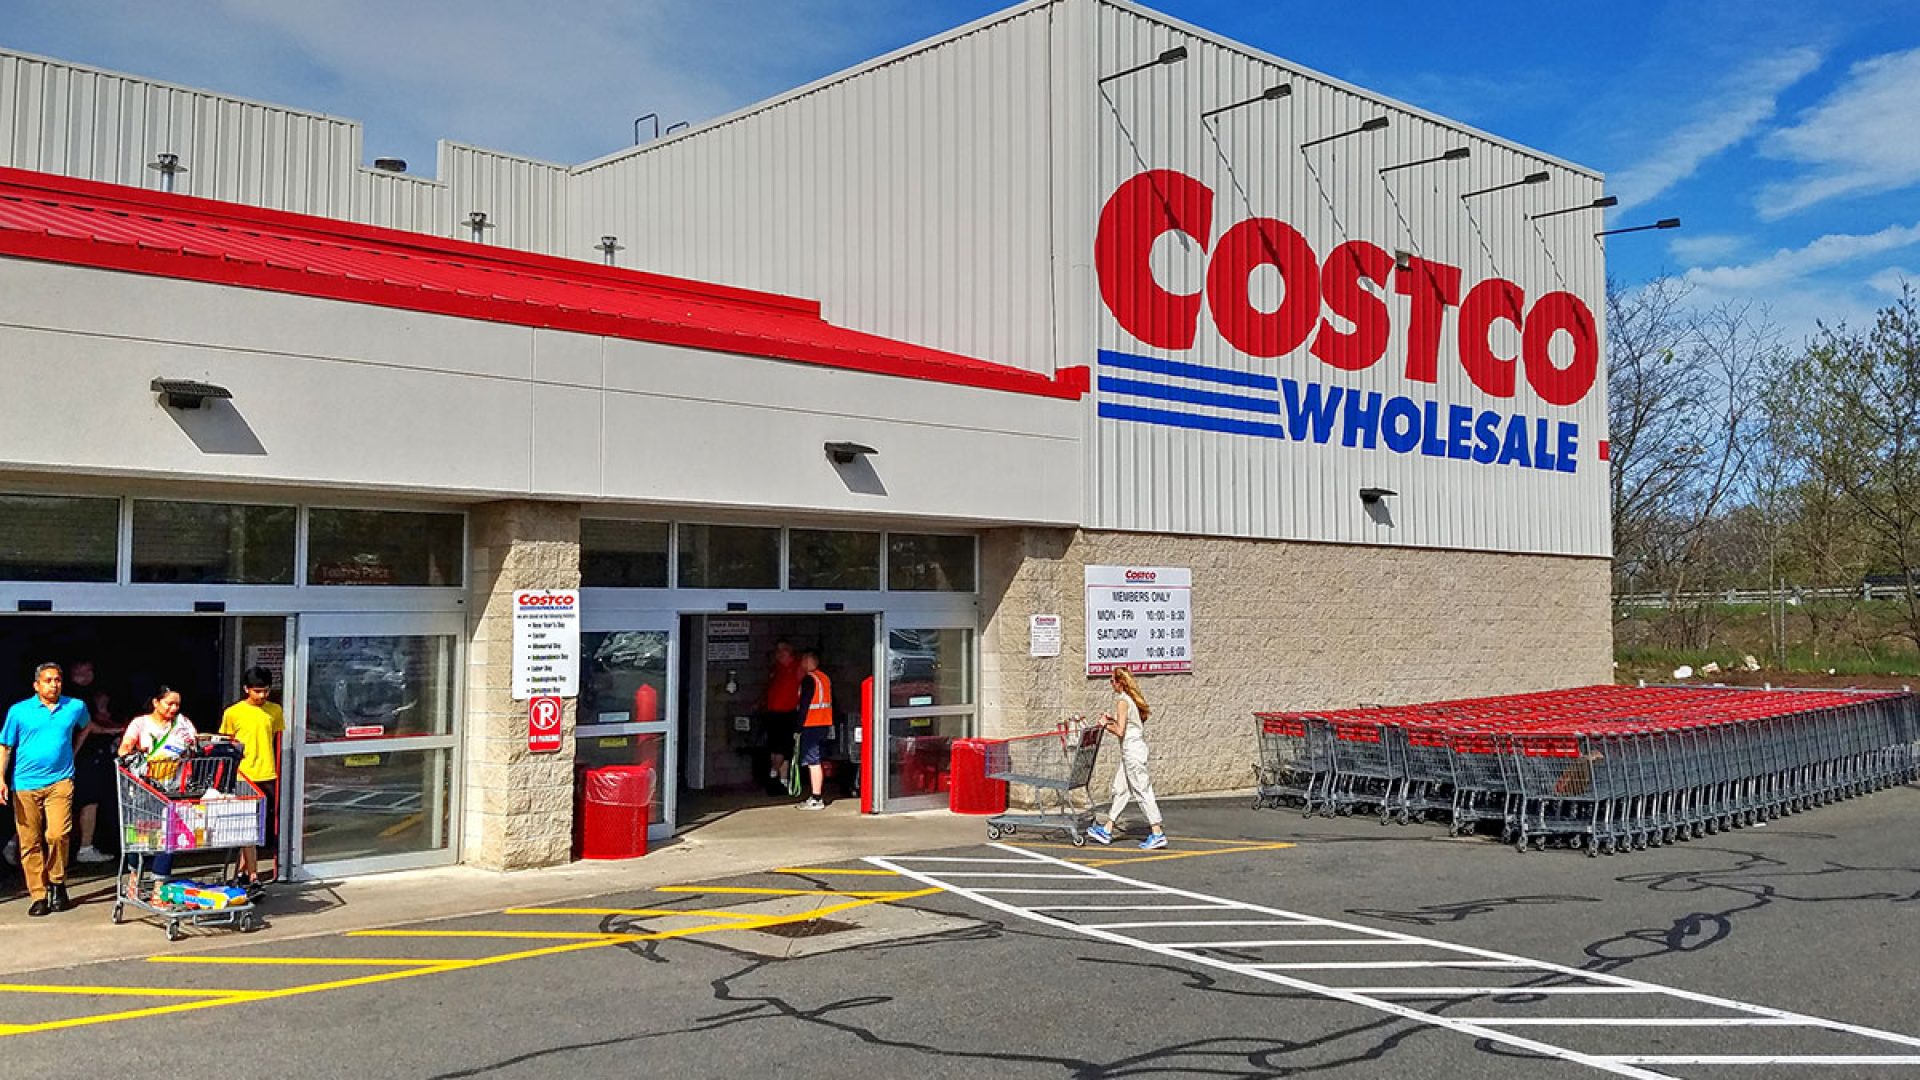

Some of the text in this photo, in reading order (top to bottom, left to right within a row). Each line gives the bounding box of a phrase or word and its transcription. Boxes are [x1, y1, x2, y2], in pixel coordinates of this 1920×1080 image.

[1095, 169, 1599, 406] COSTCO
[1282, 378, 1579, 473] WHOLESALE
[1125, 570, 1156, 579] COSTCO
[519, 594, 574, 605] COSTCO
[1112, 591, 1171, 602] MEMBERS ONLY
[1097, 610, 1116, 621] MON
[1122, 610, 1134, 621] FRI
[1146, 610, 1165, 620] 10:00
[1097, 628, 1138, 640] SATURDAY
[1097, 647, 1129, 659] SUNDAY
